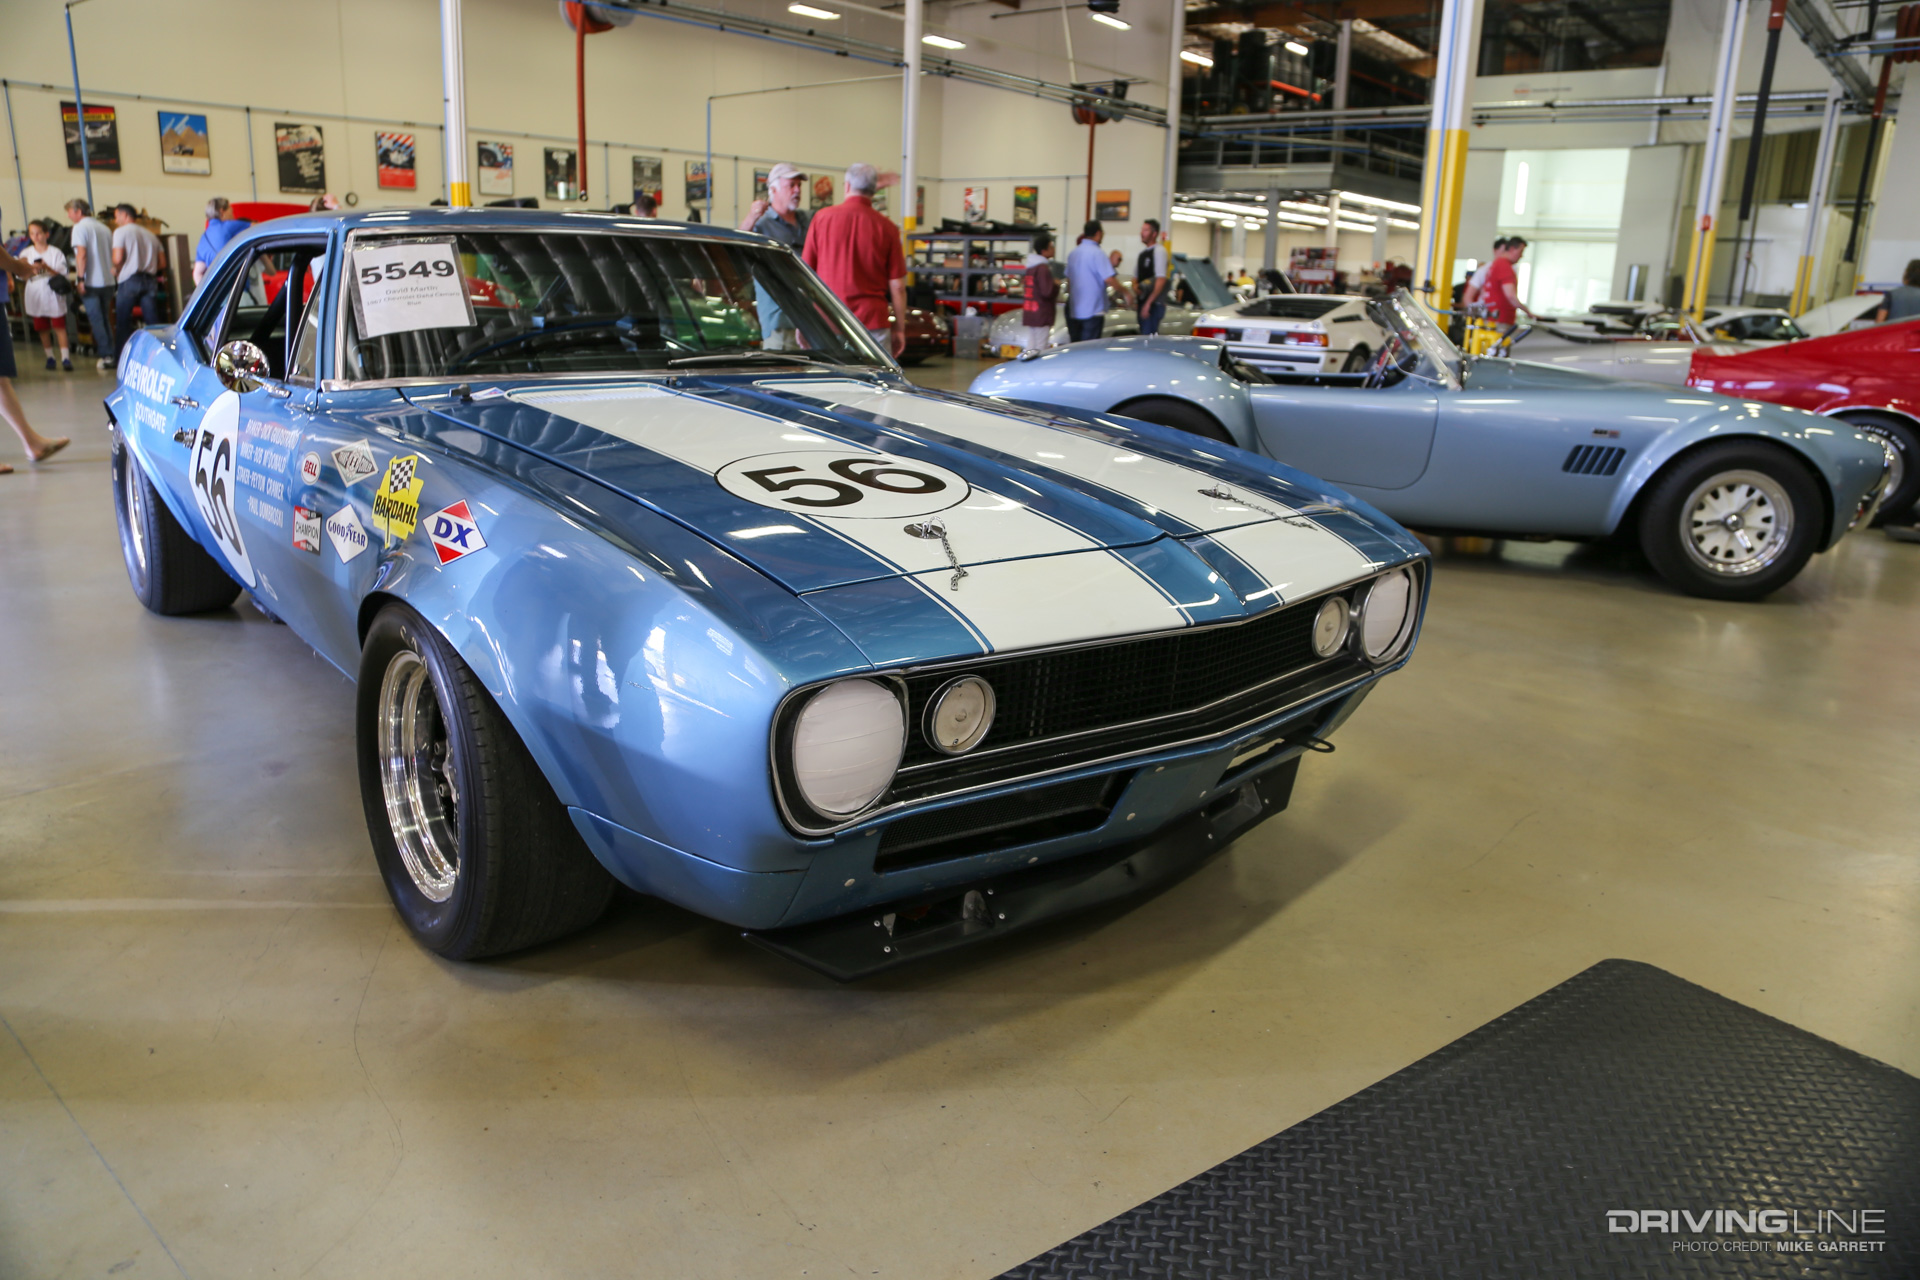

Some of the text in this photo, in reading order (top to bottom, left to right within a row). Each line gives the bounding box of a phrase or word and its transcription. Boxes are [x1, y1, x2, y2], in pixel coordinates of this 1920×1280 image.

[361, 260, 455, 285] 5549
[384, 294, 415, 302] Chevrolet
[386, 287, 408, 295] David
[124, 360, 175, 405] CHEVROLET
[134, 402, 167, 435] SOUTHGATE
[303, 462, 318, 477] BELL
[741, 458, 947, 508] 56
[196, 430, 243, 556] 56
[374, 494, 416, 527] BARDAHL
[295, 520, 320, 542] CHAMPION
[432, 515, 475, 550] DX
